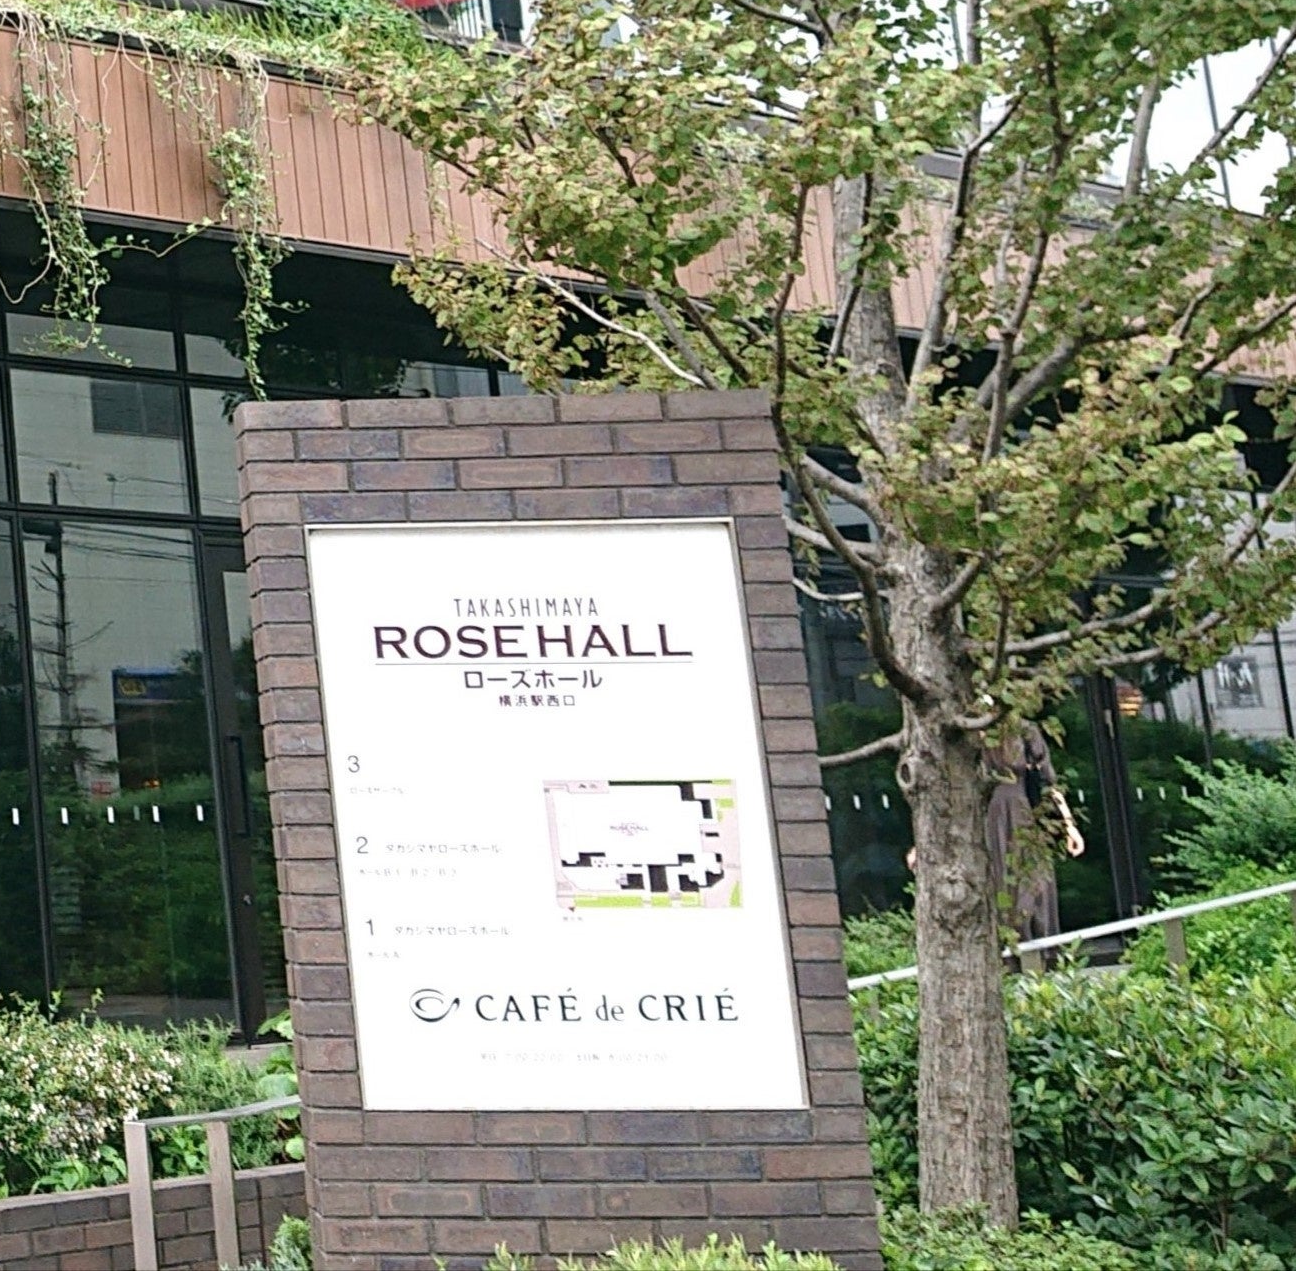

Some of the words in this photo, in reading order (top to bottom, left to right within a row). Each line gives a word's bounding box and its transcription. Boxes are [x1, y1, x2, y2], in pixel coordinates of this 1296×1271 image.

[453, 596, 600, 618] TAKASHIMAYA
[373, 624, 528, 660] ROSE
[535, 623, 694, 659] HALL
[464, 668, 603, 690] ローズホール
[498, 694, 577, 708] 横浜駅西口
[347, 754, 361, 774] 3
[355, 835, 370, 855] 2
[364, 917, 375, 937] 1
[475, 987, 582, 1023] CAFÉ
[594, 994, 625, 1023] de
[638, 987, 739, 1022] CRIÉ
